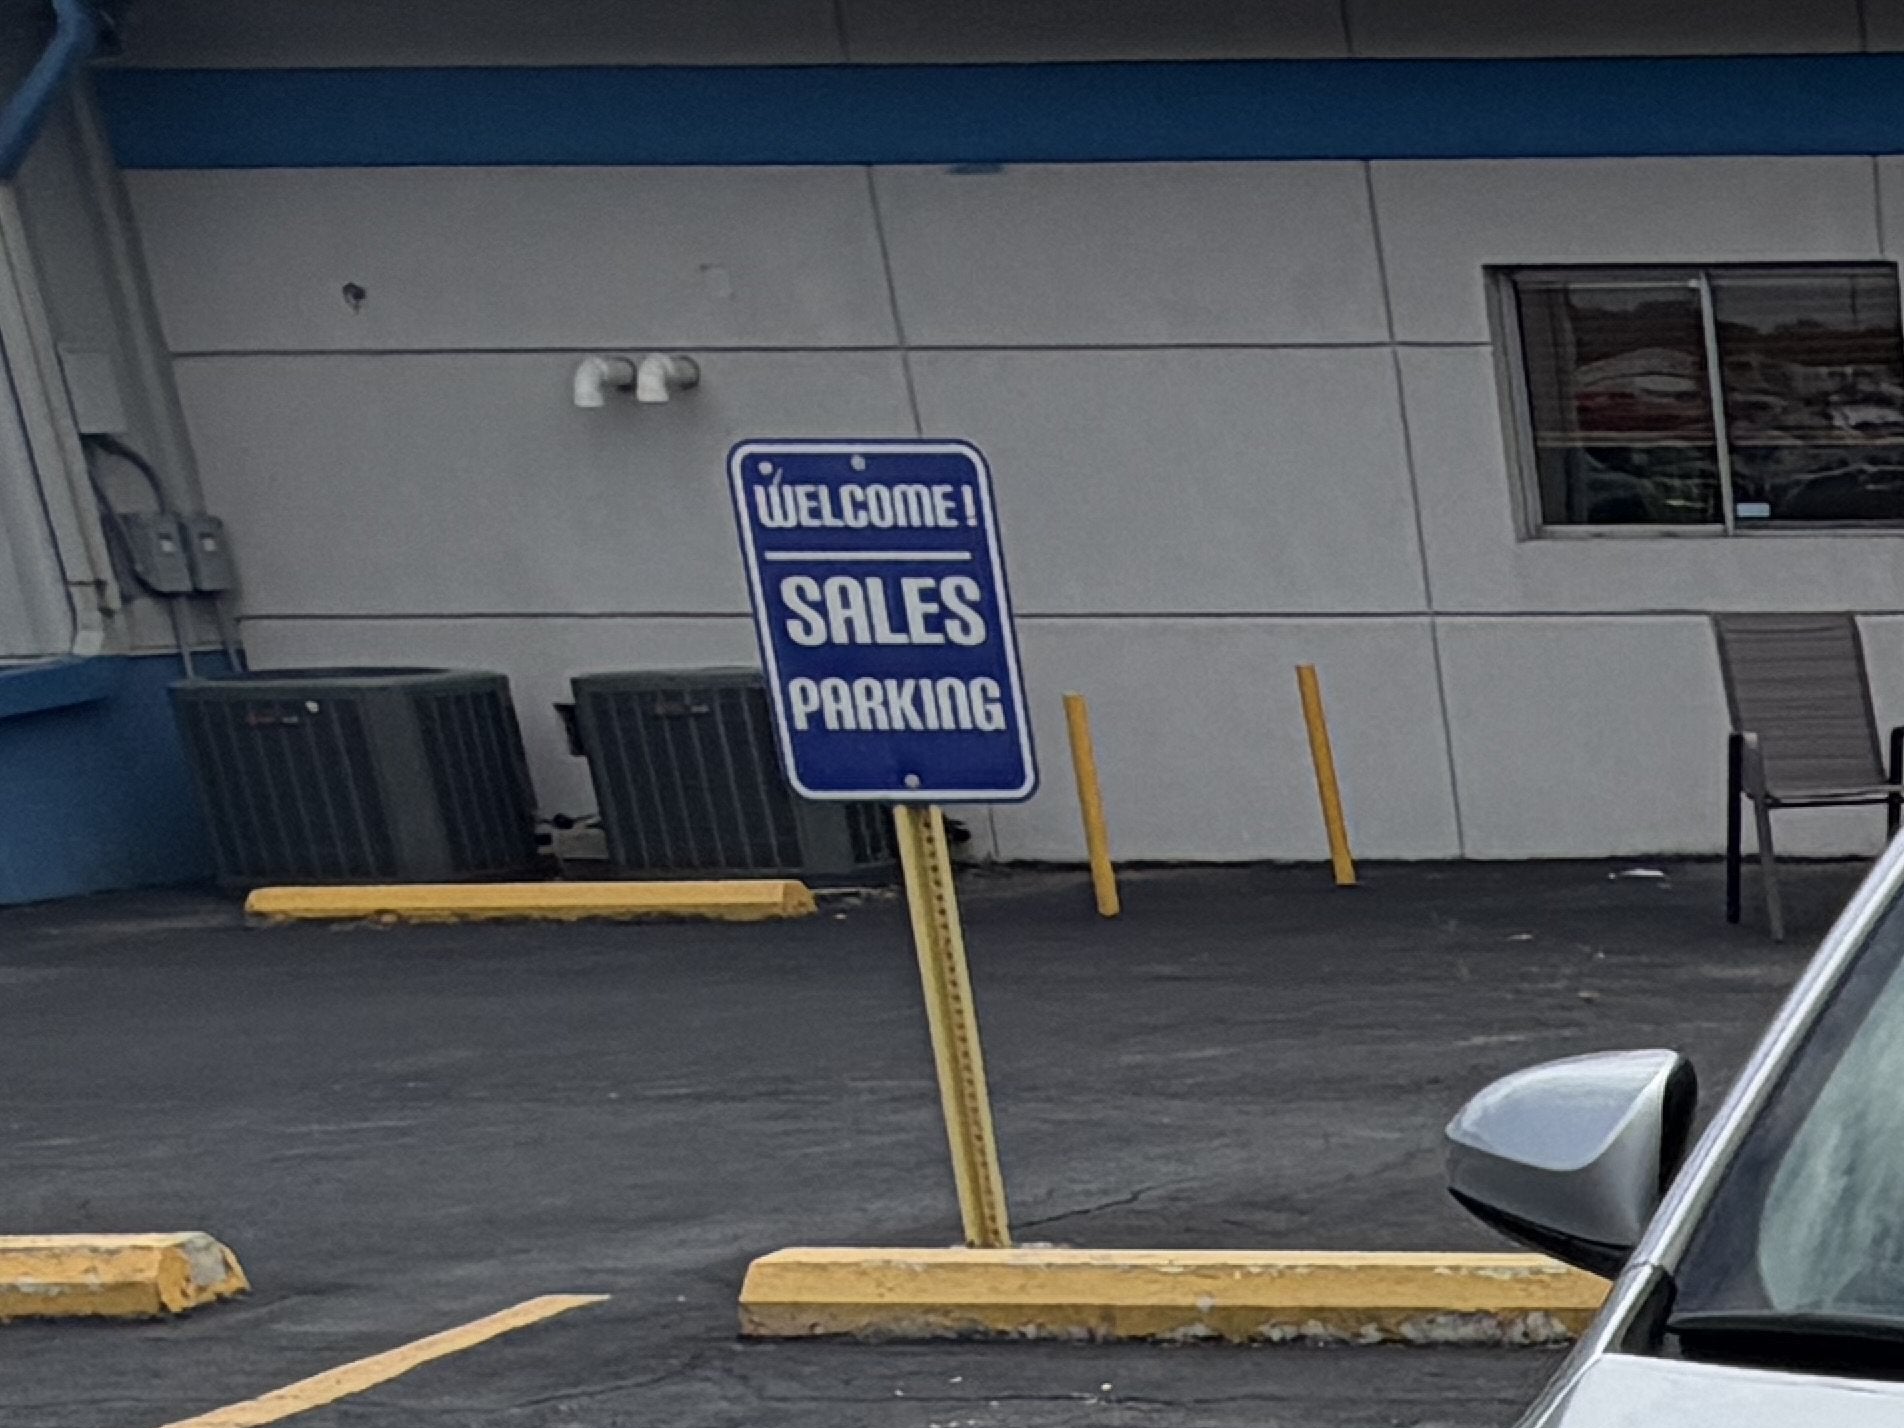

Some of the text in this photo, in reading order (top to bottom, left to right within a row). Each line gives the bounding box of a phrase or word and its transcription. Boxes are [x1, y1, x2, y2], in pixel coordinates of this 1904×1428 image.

[753, 484, 978, 529] WELCOME!
[780, 575, 987, 645] SALES
[788, 676, 1007, 732] PARKING
